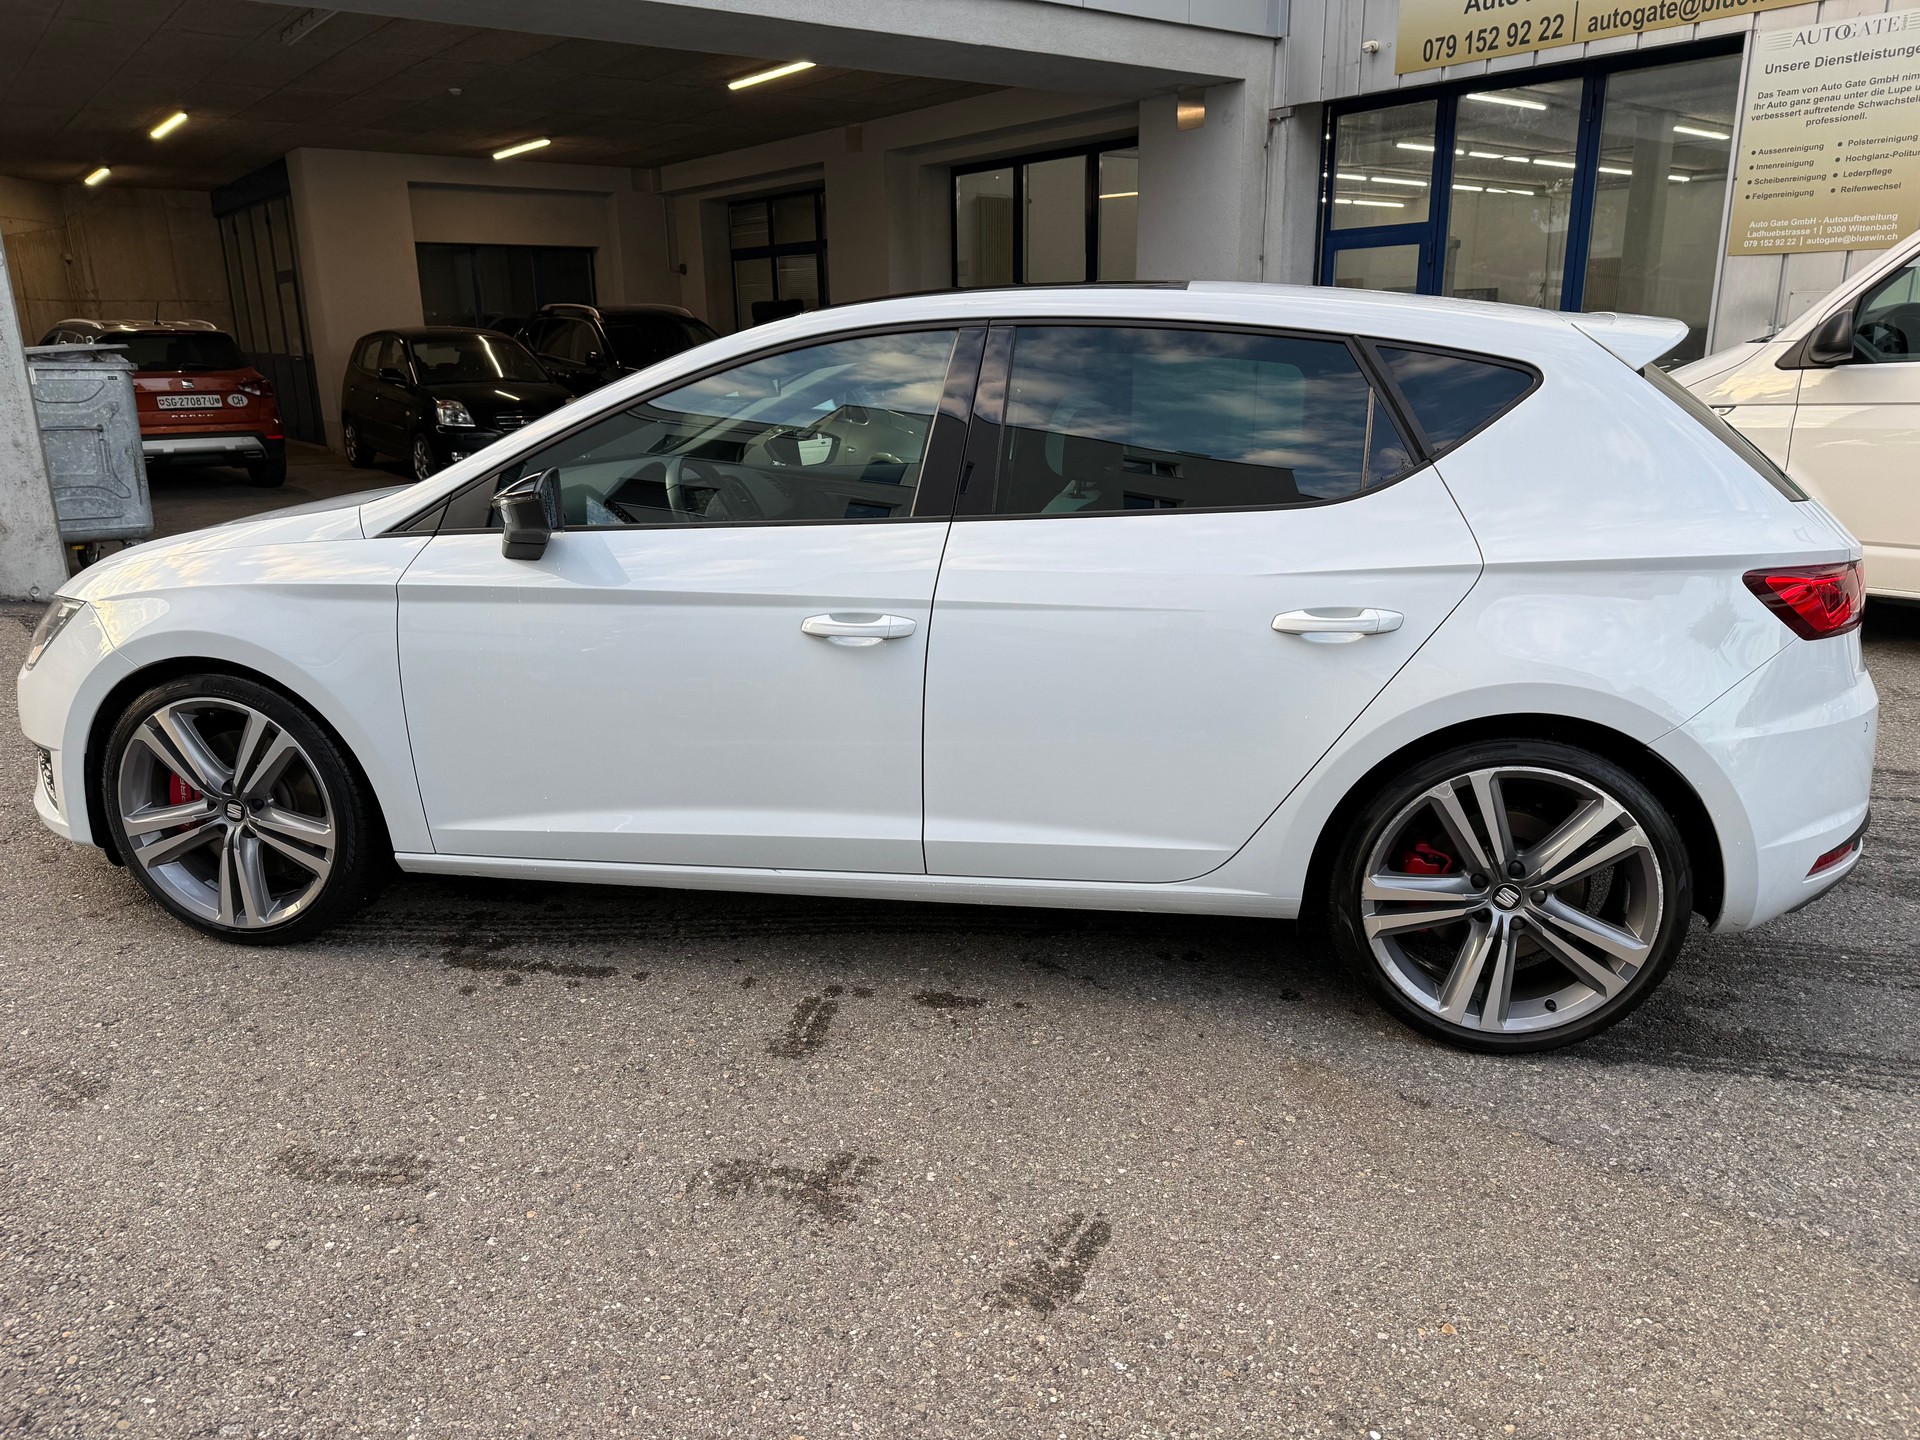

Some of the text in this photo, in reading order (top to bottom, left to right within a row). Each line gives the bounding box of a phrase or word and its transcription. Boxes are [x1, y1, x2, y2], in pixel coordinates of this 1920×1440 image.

[1422, 34, 1457, 63] 079
[1464, 25, 1500, 54] 152
[1507, 20, 1532, 47] 92
[1539, 13, 1565, 42] 22
[1765, 58, 1810, 75] Unsere
[1758, 91, 1774, 100] Das
[1776, 88, 1800, 97] Team
[1802, 86, 1818, 94] von
[1820, 83, 1842, 92] Auto
[1845, 79, 1867, 89] Gate
[1869, 74, 1899, 85] GmbH
[1753, 102, 1766, 111] Ihr
[1767, 100, 1788, 110] Auto
[1790, 98, 1811, 109] ganz
[1813, 95, 1841, 106] genau
[1844, 91, 1868, 101] unter
[1870, 87, 1885, 96] die
[1888, 85, 1912, 95] Lupe
[1803, 102, 1855, 116] auftretende
[1805, 112, 1868, 127] professionell.
[1847, 134, 1918, 147] Polsterreinigung
[1758, 143, 1824, 156] Aussenreinigung
[1756, 159, 1814, 171] Innenreinigung
[1754, 173, 1827, 186] Scheibenreinigung
[1843, 167, 1893, 178] Lederpflege
[1840, 182, 1902, 193] Reifenwechsel
[1752, 189, 1815, 201] Felgenreinigung
[1749, 220, 1768, 229] Auto
[1770, 218, 1789, 227] Gate
[1790, 216, 1817, 226] GmbH
[1823, 212, 1899, 224] Autoaufbereitung
[1747, 226, 1811, 238] Ladhuebstrasse
[1826, 224, 1846, 234] 9300
[1848, 222, 1898, 233] Wittenbach
[1743, 239, 1758, 248] 079
[1760, 239, 1773, 247] 152
[1775, 238, 1785, 246] 92
[1786, 238, 1797, 246] 22
[1806, 233, 1898, 245] autogate@bluewin.ch
[232, 396, 244, 405] CH
